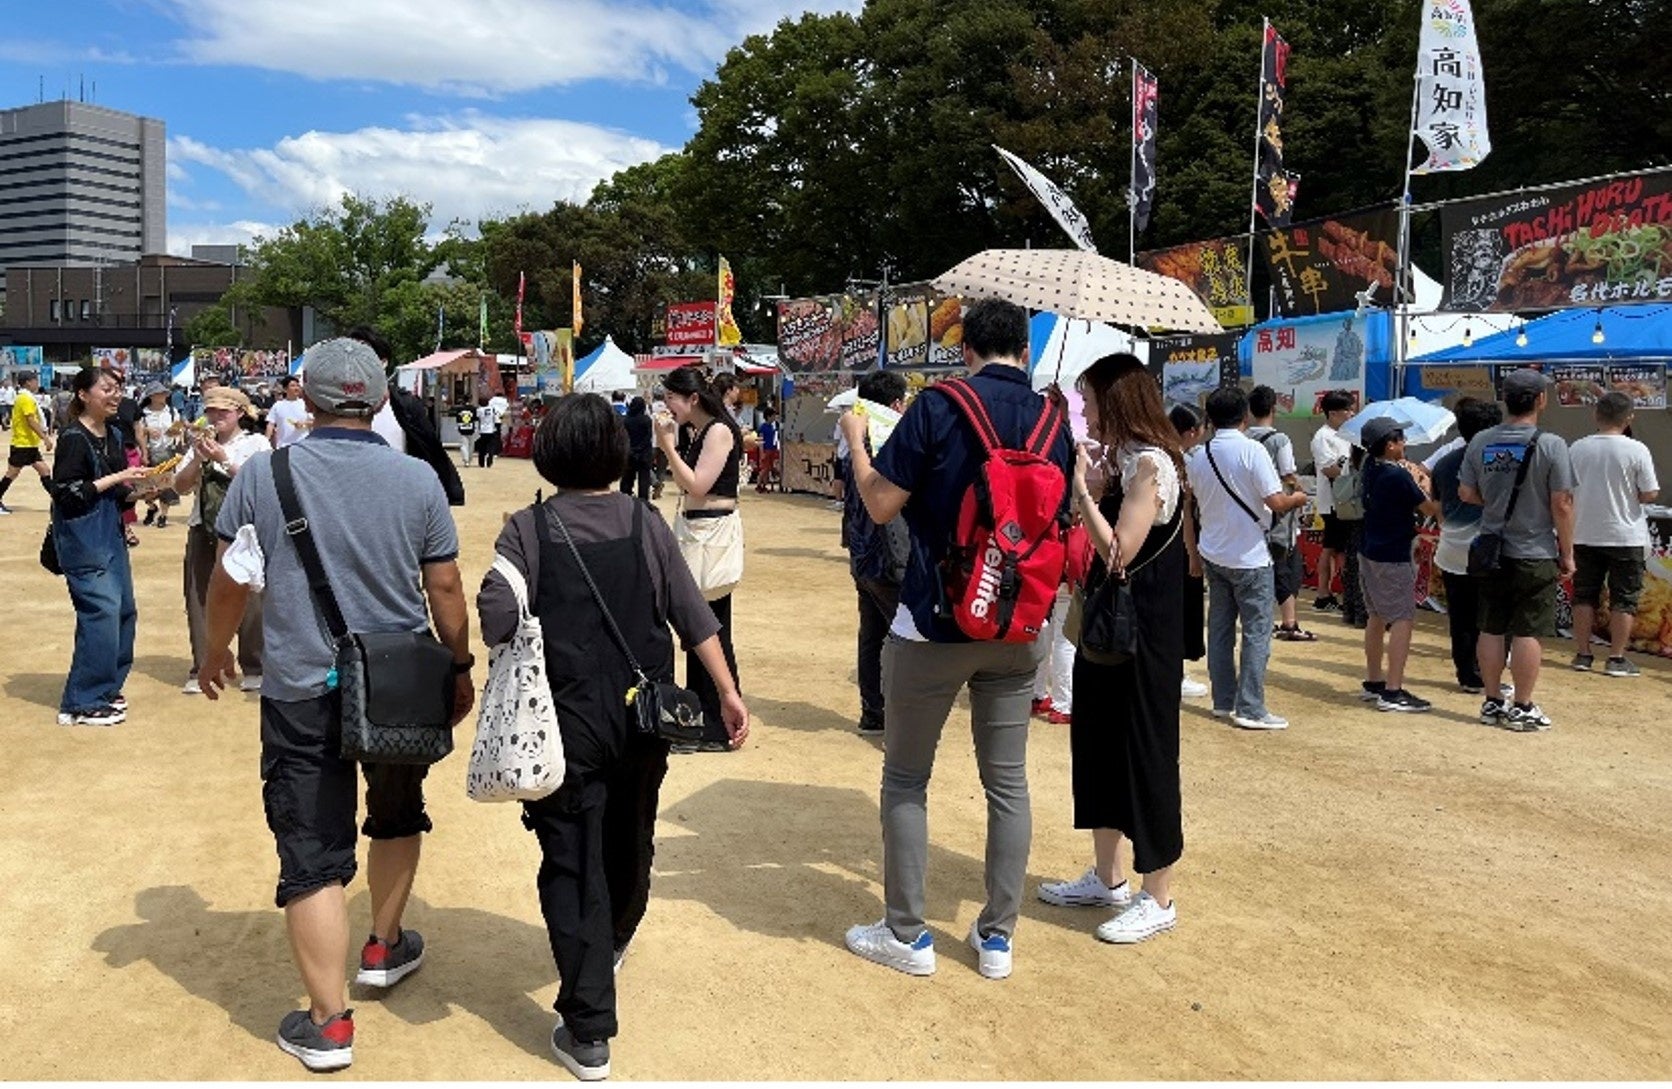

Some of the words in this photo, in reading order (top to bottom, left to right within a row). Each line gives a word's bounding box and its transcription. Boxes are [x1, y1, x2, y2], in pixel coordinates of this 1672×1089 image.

[1430, 47, 1463, 151] 高知家
[1267, 230, 1328, 314] 牛串
[1256, 327, 1295, 353] 高知
